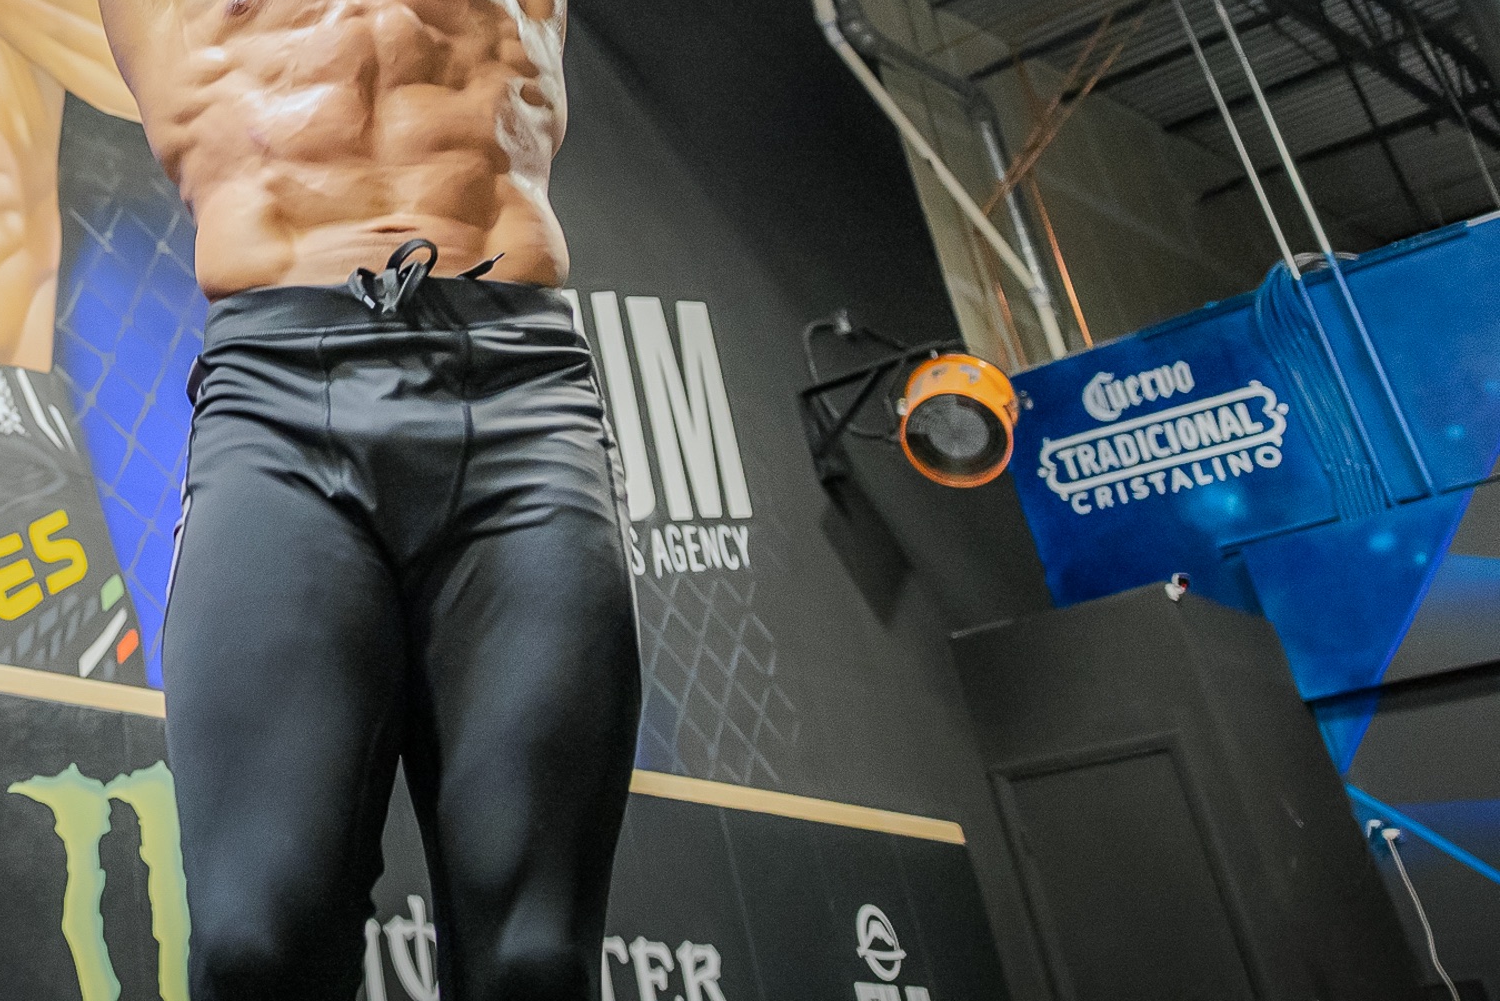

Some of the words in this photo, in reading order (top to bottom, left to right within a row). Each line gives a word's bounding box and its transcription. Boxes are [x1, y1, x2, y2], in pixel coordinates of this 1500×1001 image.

[1082, 360, 1196, 422] Cuervo
[1056, 402, 1264, 480] TRADICIONAL
[1071, 445, 1283, 515] CRISTALINO
[651, 523, 751, 580] AGENCY
